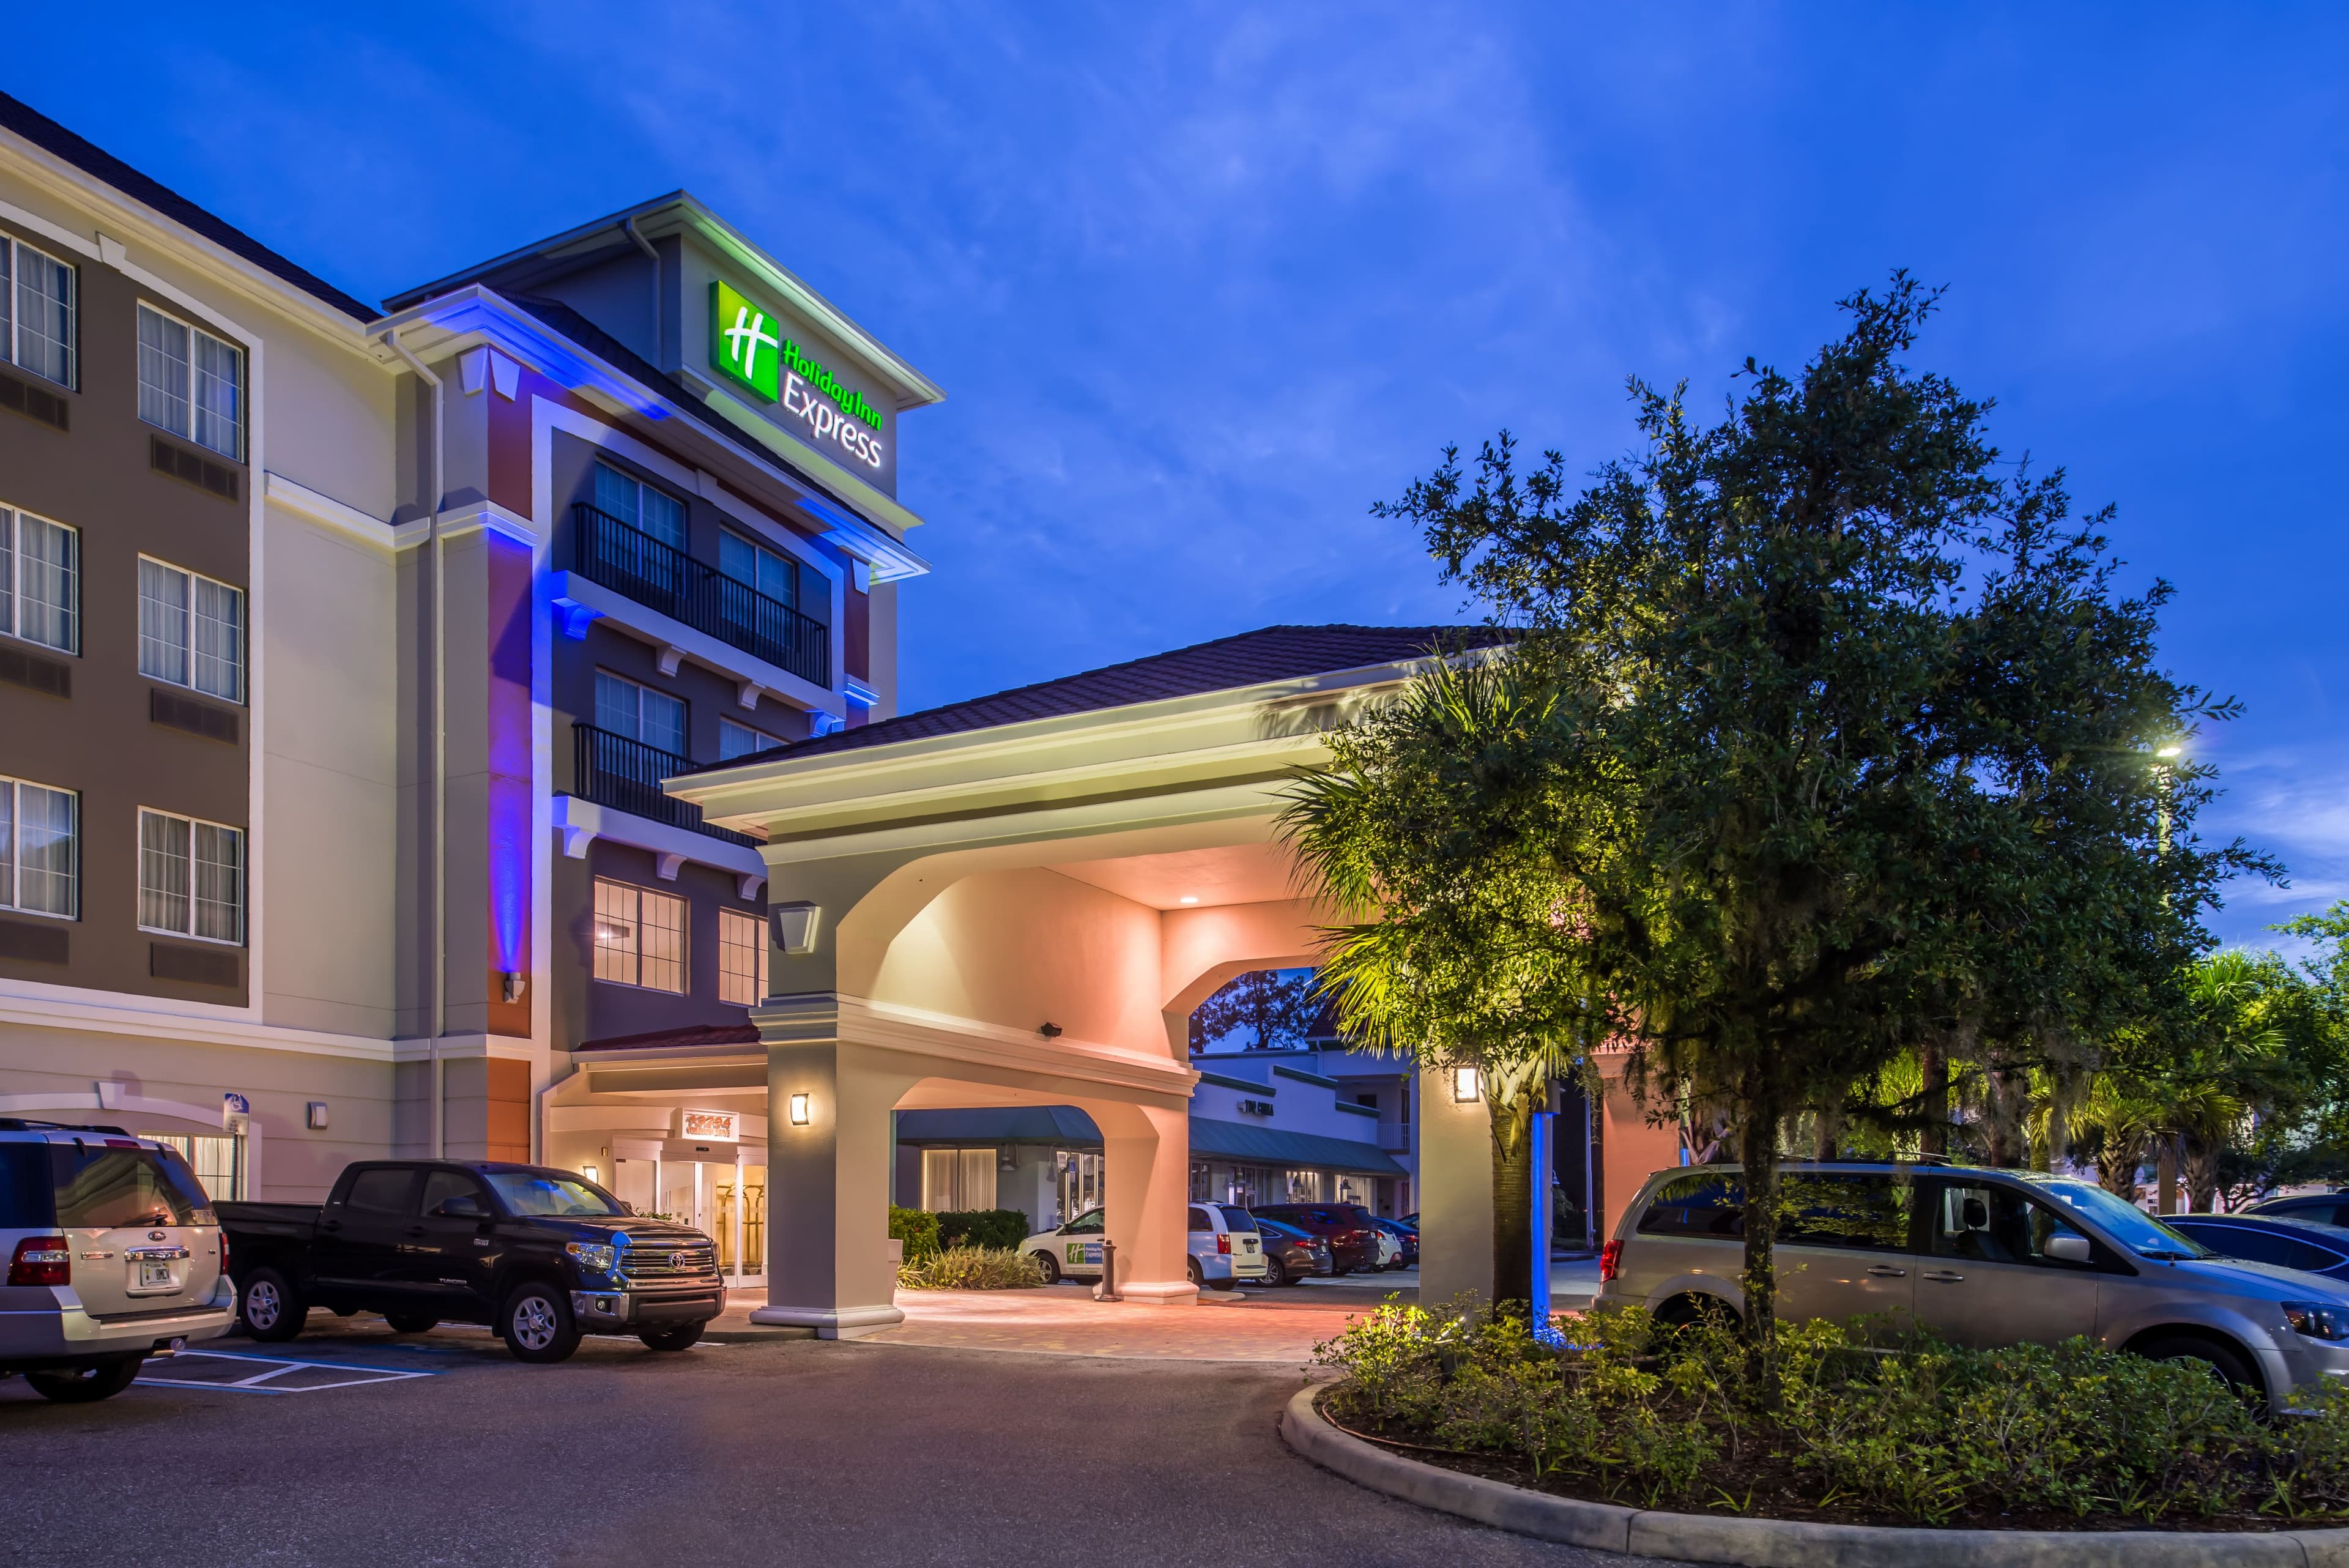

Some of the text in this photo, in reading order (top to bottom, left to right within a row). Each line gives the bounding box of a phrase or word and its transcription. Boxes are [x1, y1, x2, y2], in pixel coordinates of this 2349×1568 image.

[782, 338, 882, 431] Holiday Inn
[783, 371, 882, 468] Express
